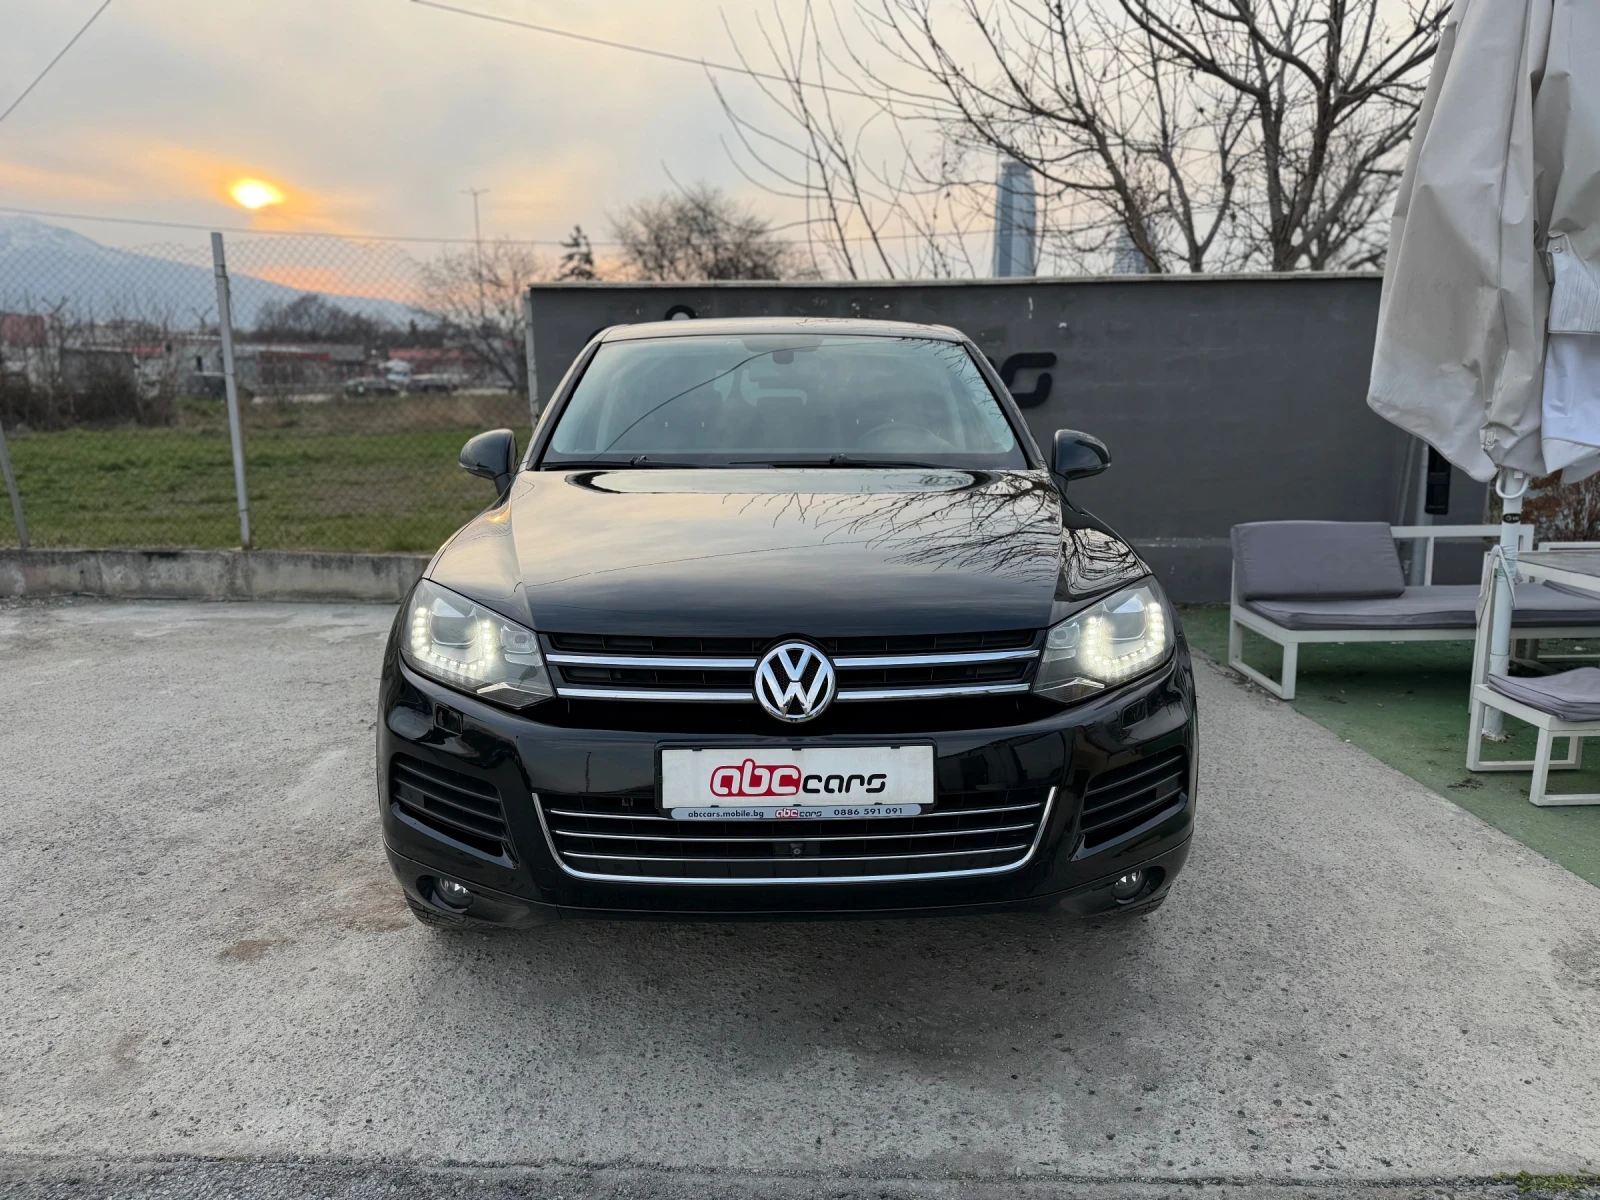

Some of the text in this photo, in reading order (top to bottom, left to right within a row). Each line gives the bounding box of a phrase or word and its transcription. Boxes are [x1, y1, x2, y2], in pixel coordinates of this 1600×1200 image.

[710, 758, 887, 798] abc cars
[688, 807, 903, 818] abccars.mobile.bg abc cars 0886 591 091
